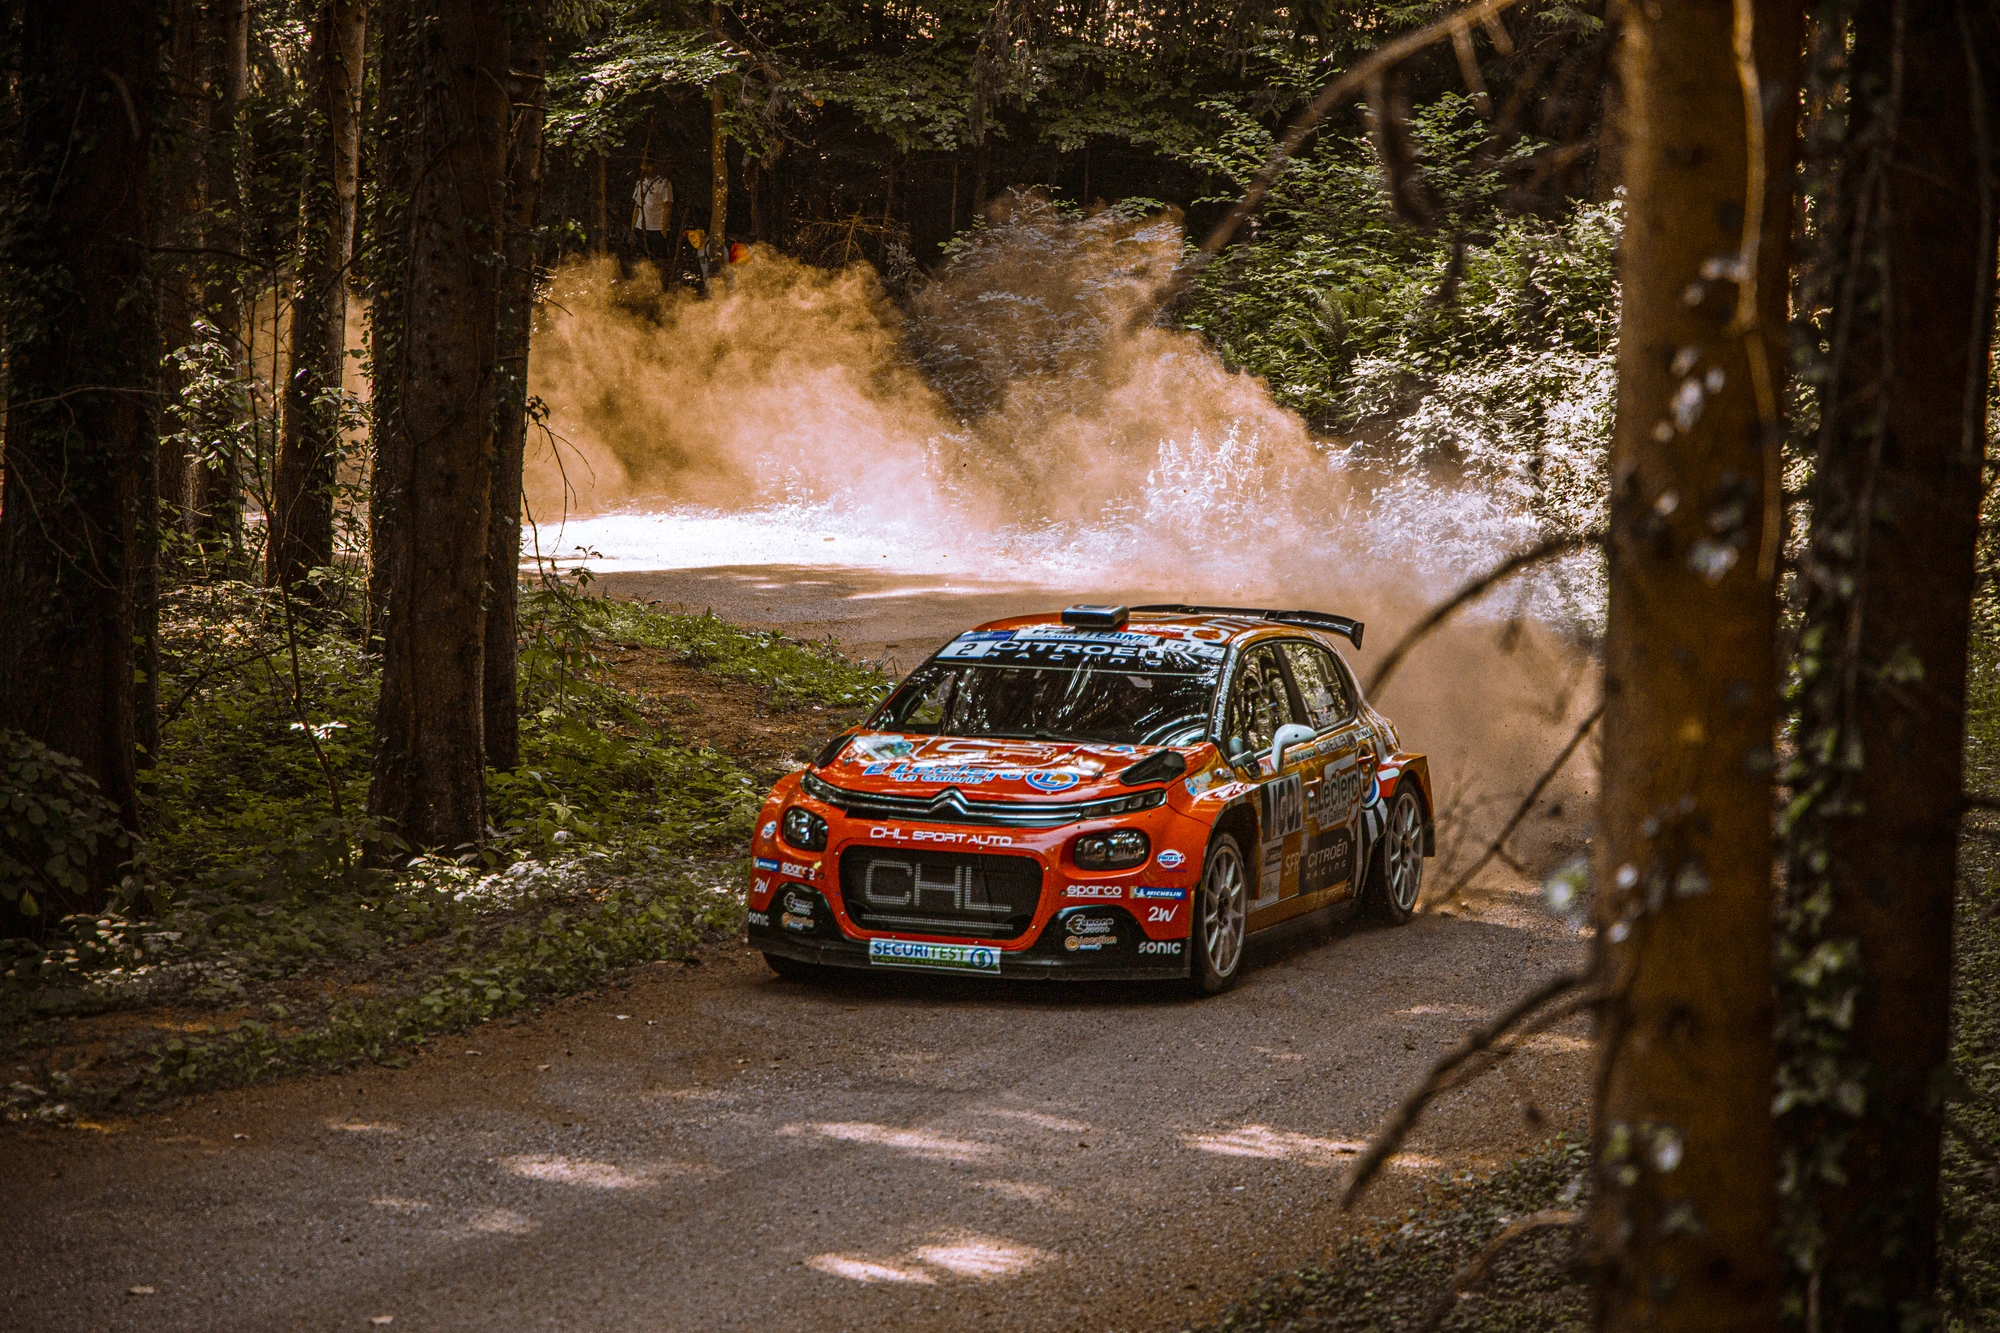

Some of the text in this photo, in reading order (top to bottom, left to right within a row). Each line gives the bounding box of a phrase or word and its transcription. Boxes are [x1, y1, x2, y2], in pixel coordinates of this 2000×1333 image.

[956, 643, 978, 656] 2
[993, 641, 1164, 659] CITROËN
[870, 827, 1012, 846] CHL SPORT AUTO
[754, 877, 771, 894] 2W
[865, 859, 1012, 912] CHL
[1066, 885, 1122, 898] sparco
[1146, 890, 1182, 898] MICHELIN
[1148, 904, 1179, 922] 2W
[873, 942, 967, 960] SECURITEST
